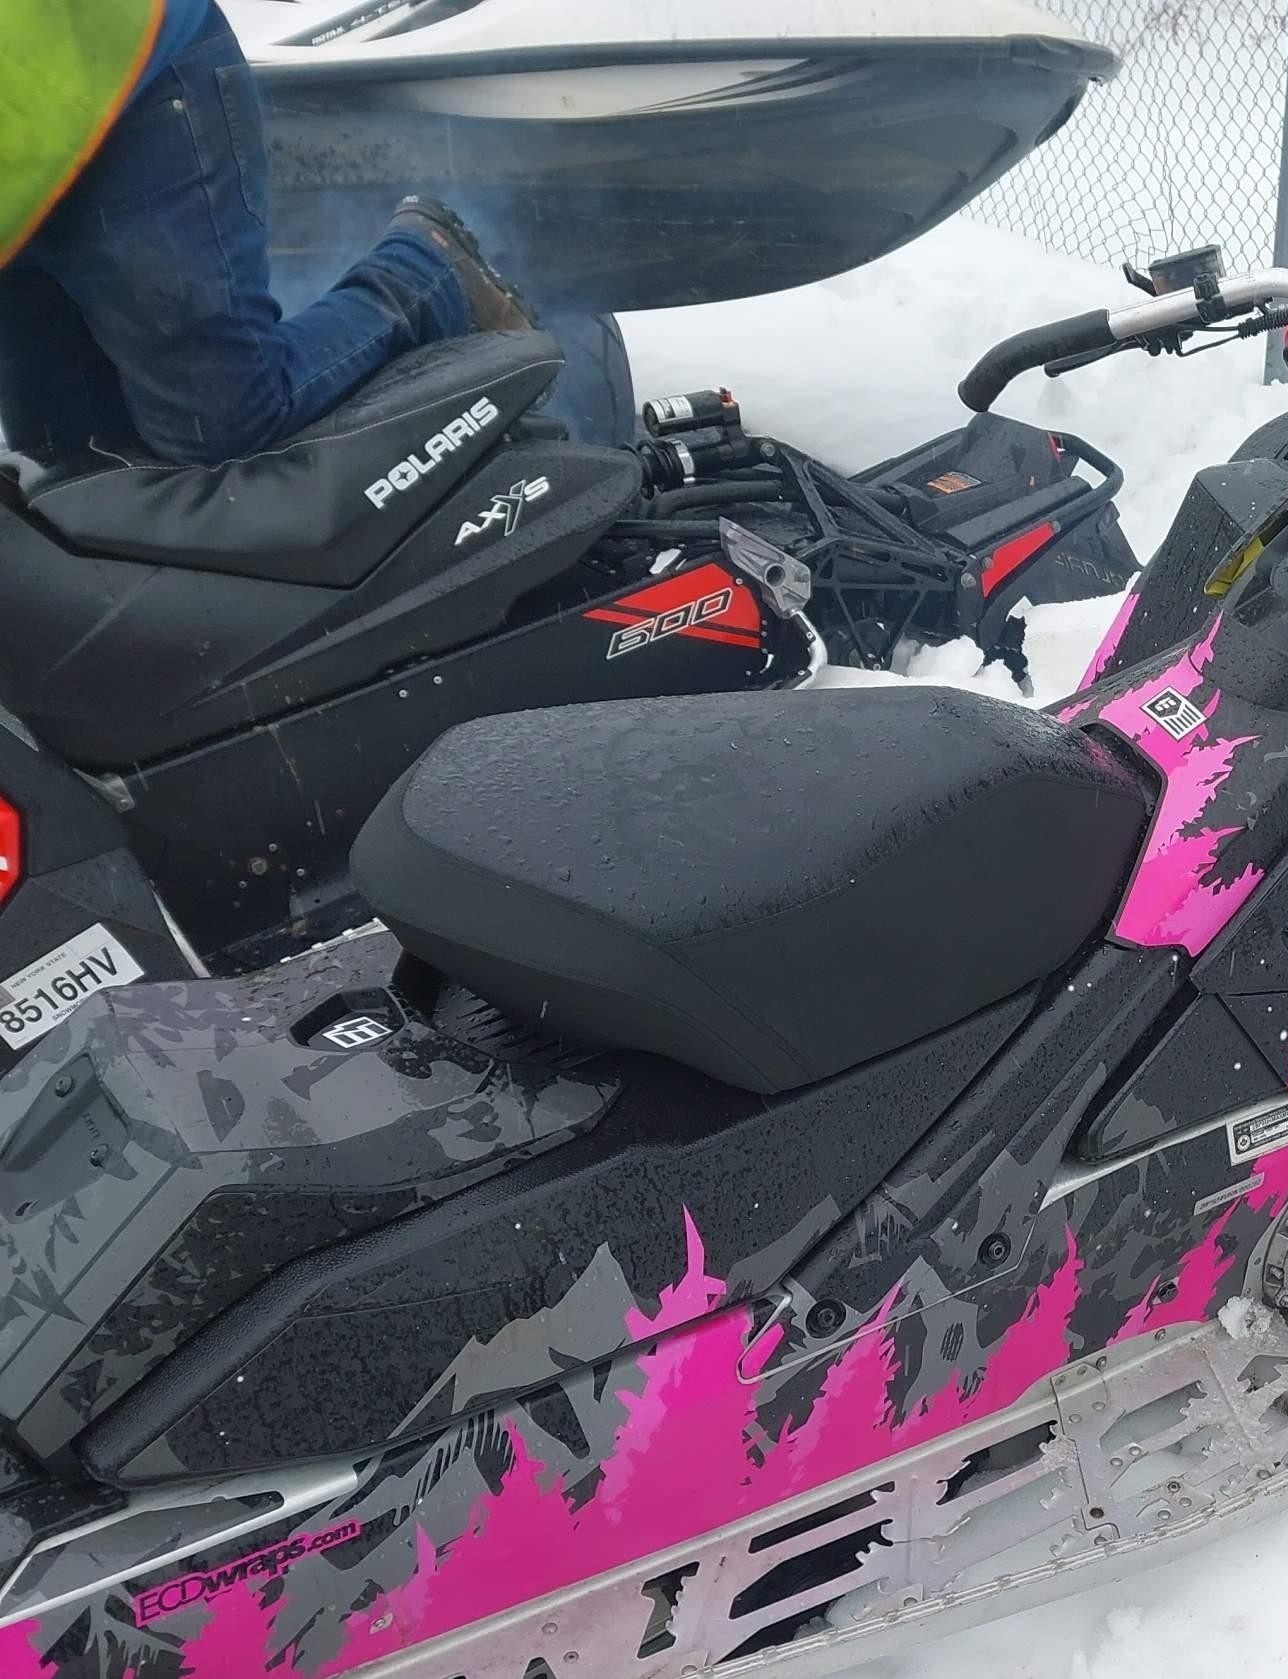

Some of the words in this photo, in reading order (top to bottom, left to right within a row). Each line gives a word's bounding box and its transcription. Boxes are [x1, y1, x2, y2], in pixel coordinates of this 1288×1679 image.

[364, 396, 499, 510] POLARIS
[606, 587, 733, 660] 600
[0, 946, 118, 1033] 8516HV
[45, 952, 67, 967] STATE
[139, 1522, 356, 1621] ECDwraps.com
